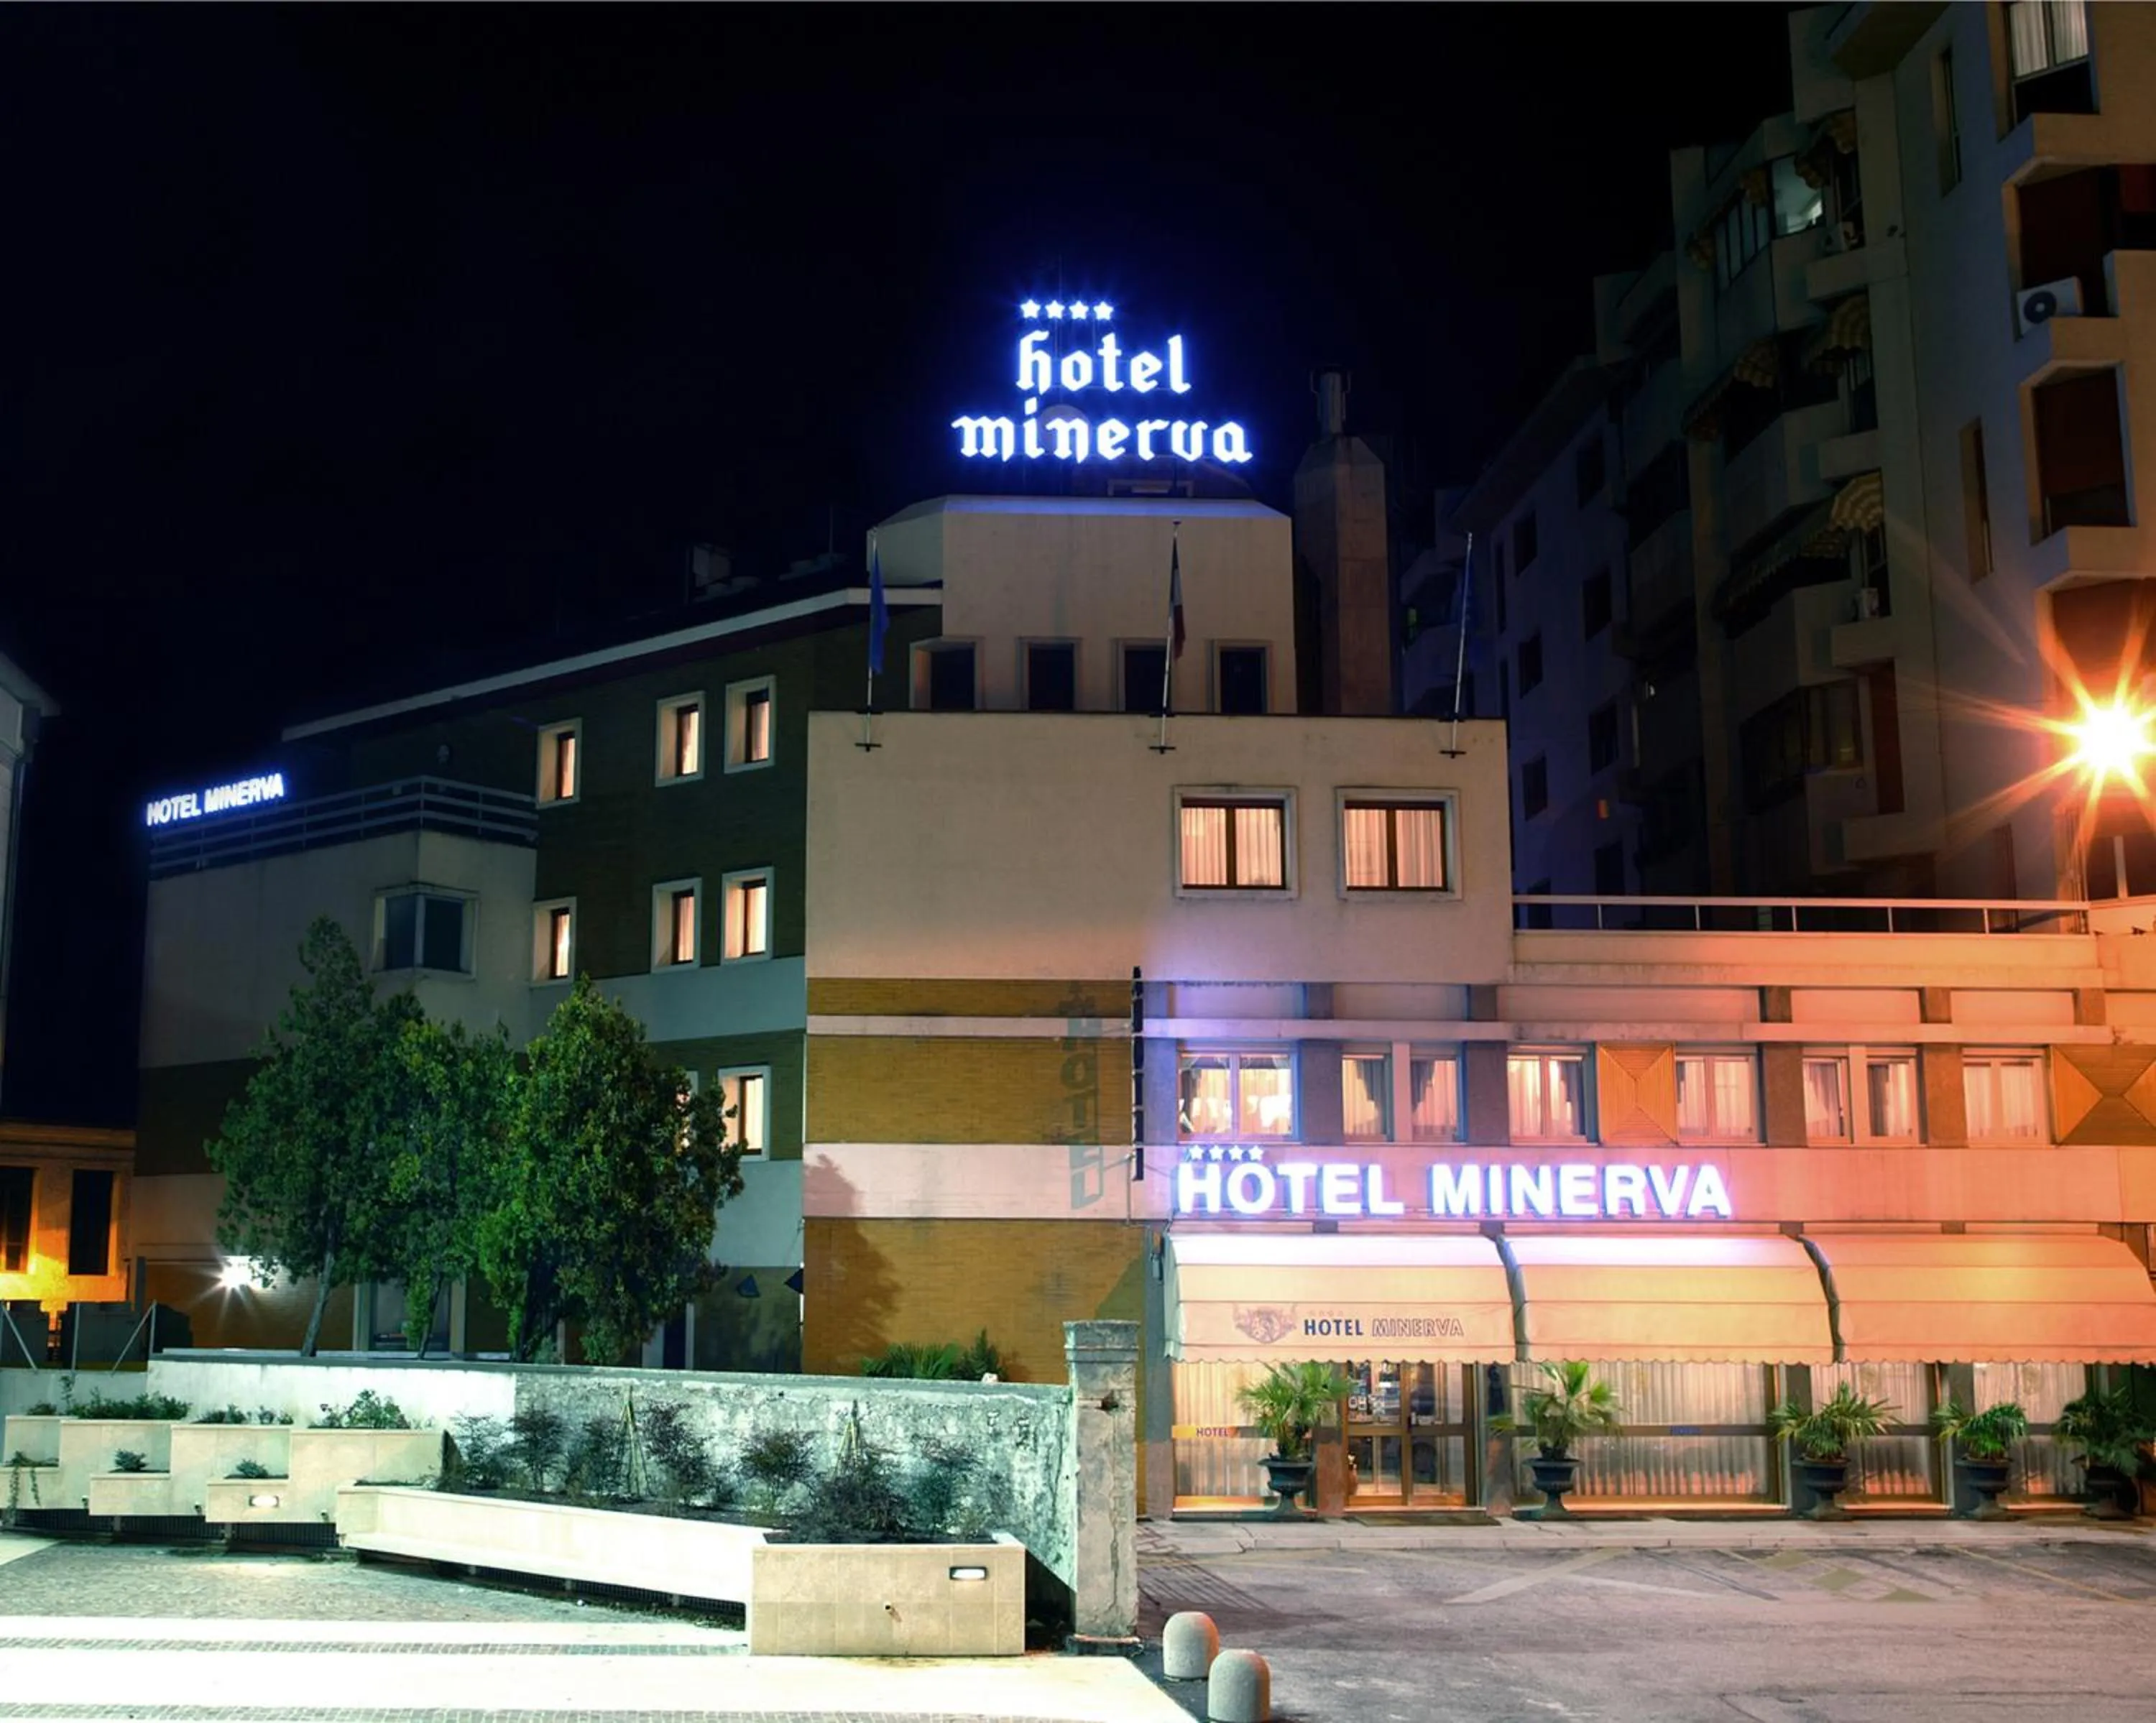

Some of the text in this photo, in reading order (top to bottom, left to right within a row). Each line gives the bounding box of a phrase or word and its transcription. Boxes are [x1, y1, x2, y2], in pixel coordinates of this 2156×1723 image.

[1015, 329, 1192, 394] hotel
[951, 397, 1253, 463] minerva
[147, 772, 284, 826] HOTEL MINERVA
[1177, 1162, 1733, 1216] HOTEL MINERVA
[1304, 1318, 1464, 1337] HOTEL MINERVA
[1196, 1427, 1229, 1437] HOTEL
